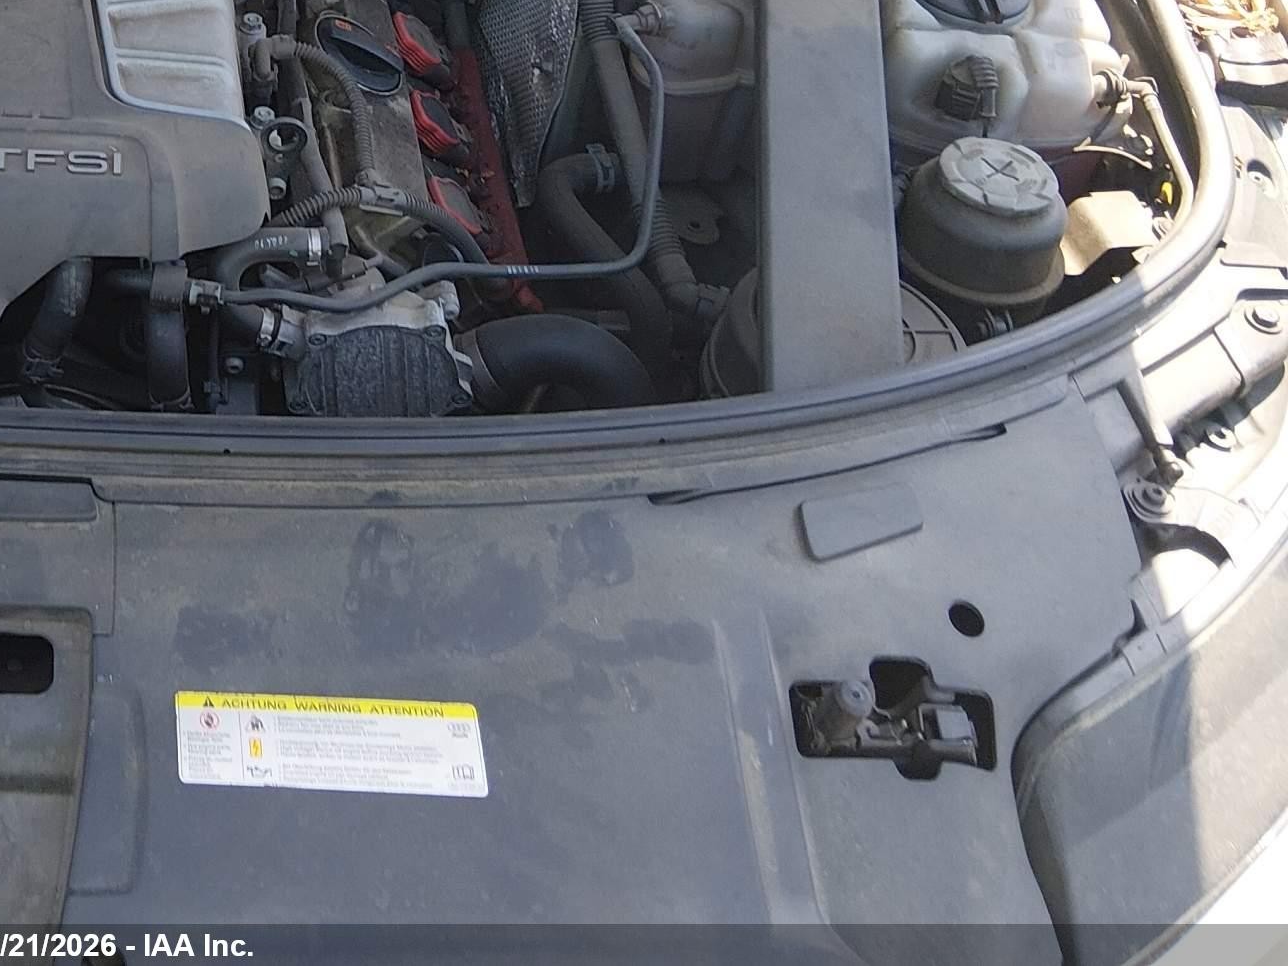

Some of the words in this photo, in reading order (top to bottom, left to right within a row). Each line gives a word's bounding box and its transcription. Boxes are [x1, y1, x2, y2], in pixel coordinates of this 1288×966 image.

[221, 697, 288, 711] ACHTUNG
[294, 701, 362, 715] WARNING
[368, 704, 444, 719] ATTENTION
